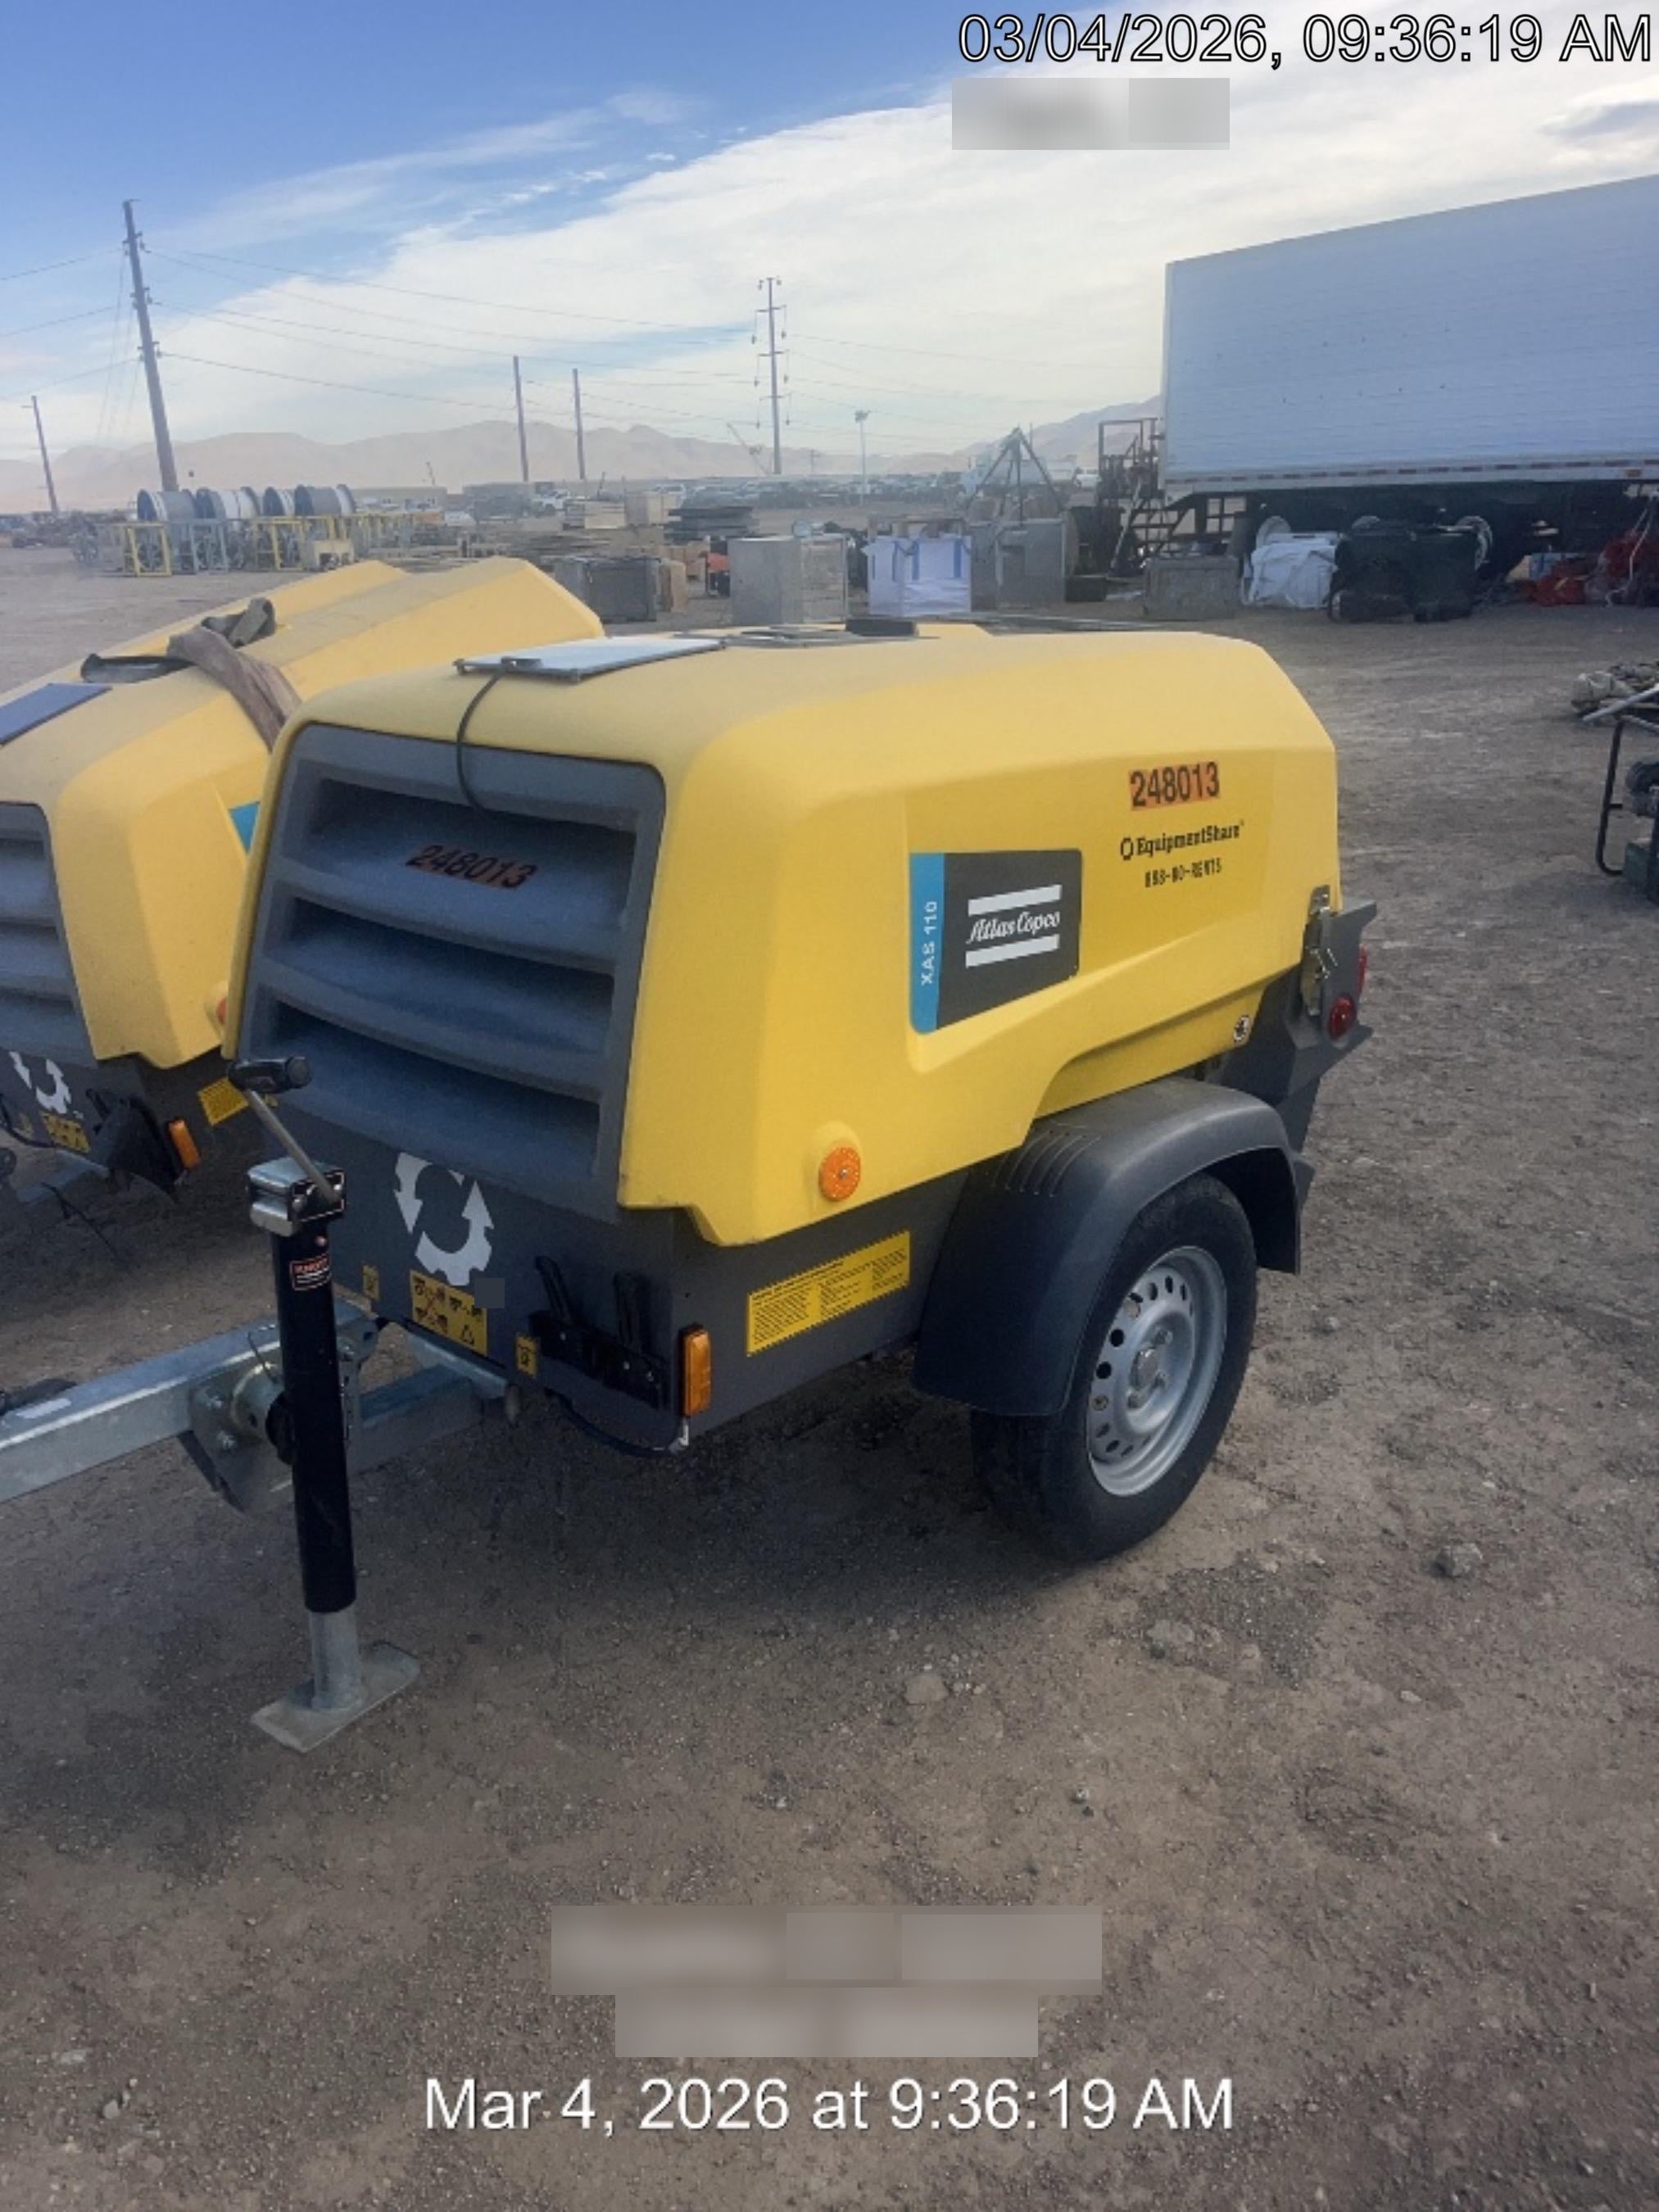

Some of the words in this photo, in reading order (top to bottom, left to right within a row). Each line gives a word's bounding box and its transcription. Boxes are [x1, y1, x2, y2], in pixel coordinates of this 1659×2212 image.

[1130, 761, 1221, 807] 248013
[406, 845, 537, 888] 248013
[923, 901, 939, 936] 110
[965, 918, 1016, 945] Atlas
[1017, 910, 1061, 935] Copco
[921, 941, 936, 986] XAS
